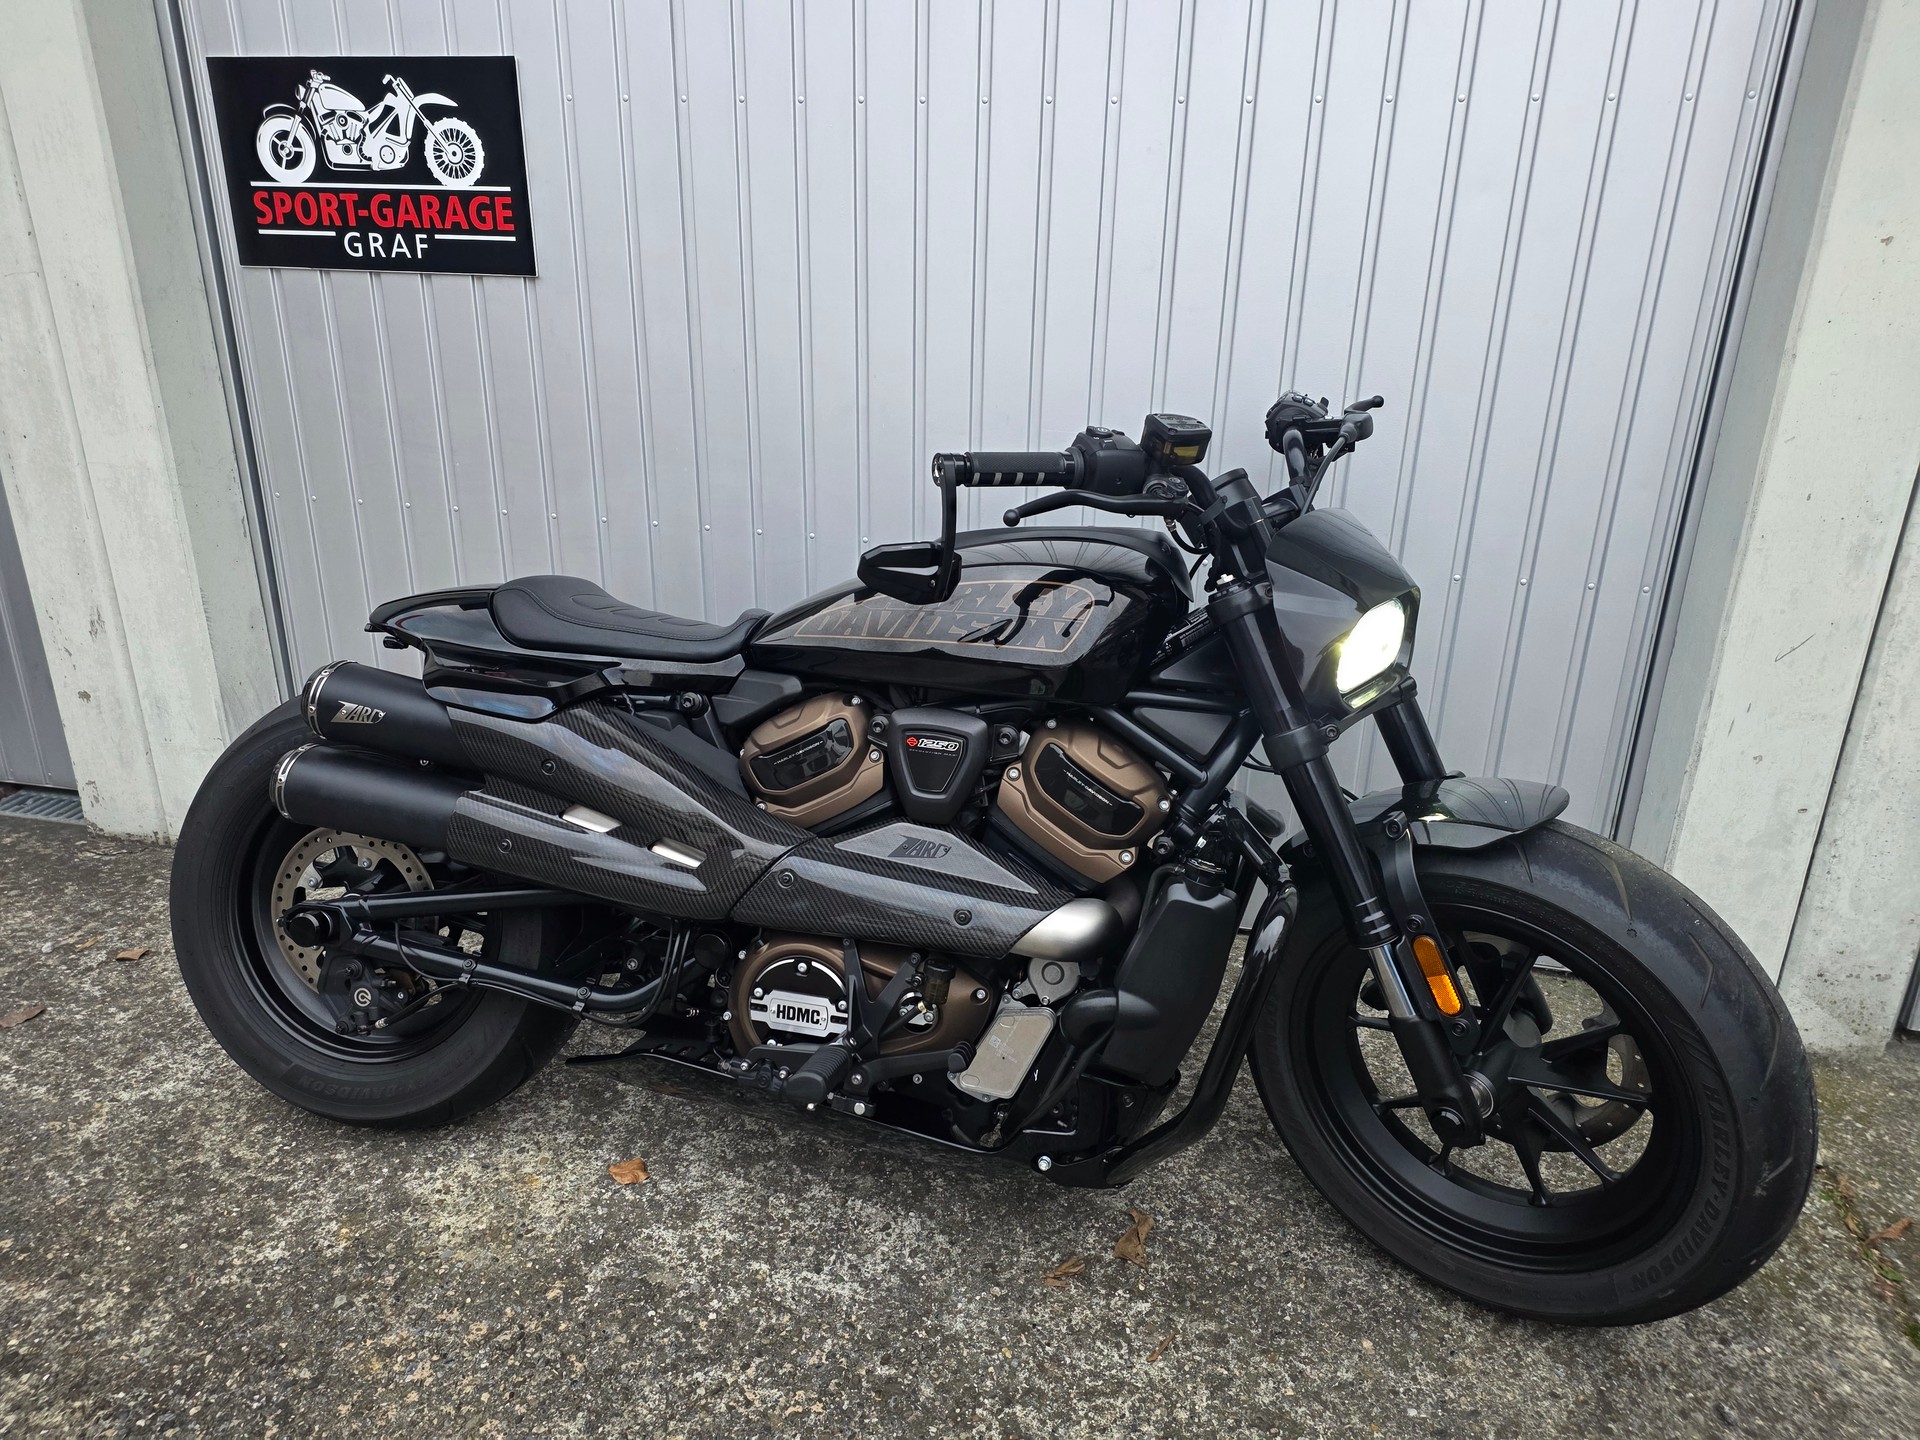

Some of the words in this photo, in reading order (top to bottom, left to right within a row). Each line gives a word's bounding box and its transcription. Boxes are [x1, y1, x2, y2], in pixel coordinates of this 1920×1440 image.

[252, 190, 515, 231] SPORT-GARAGE
[343, 231, 429, 259] GRAF
[918, 738, 959, 751] 1250
